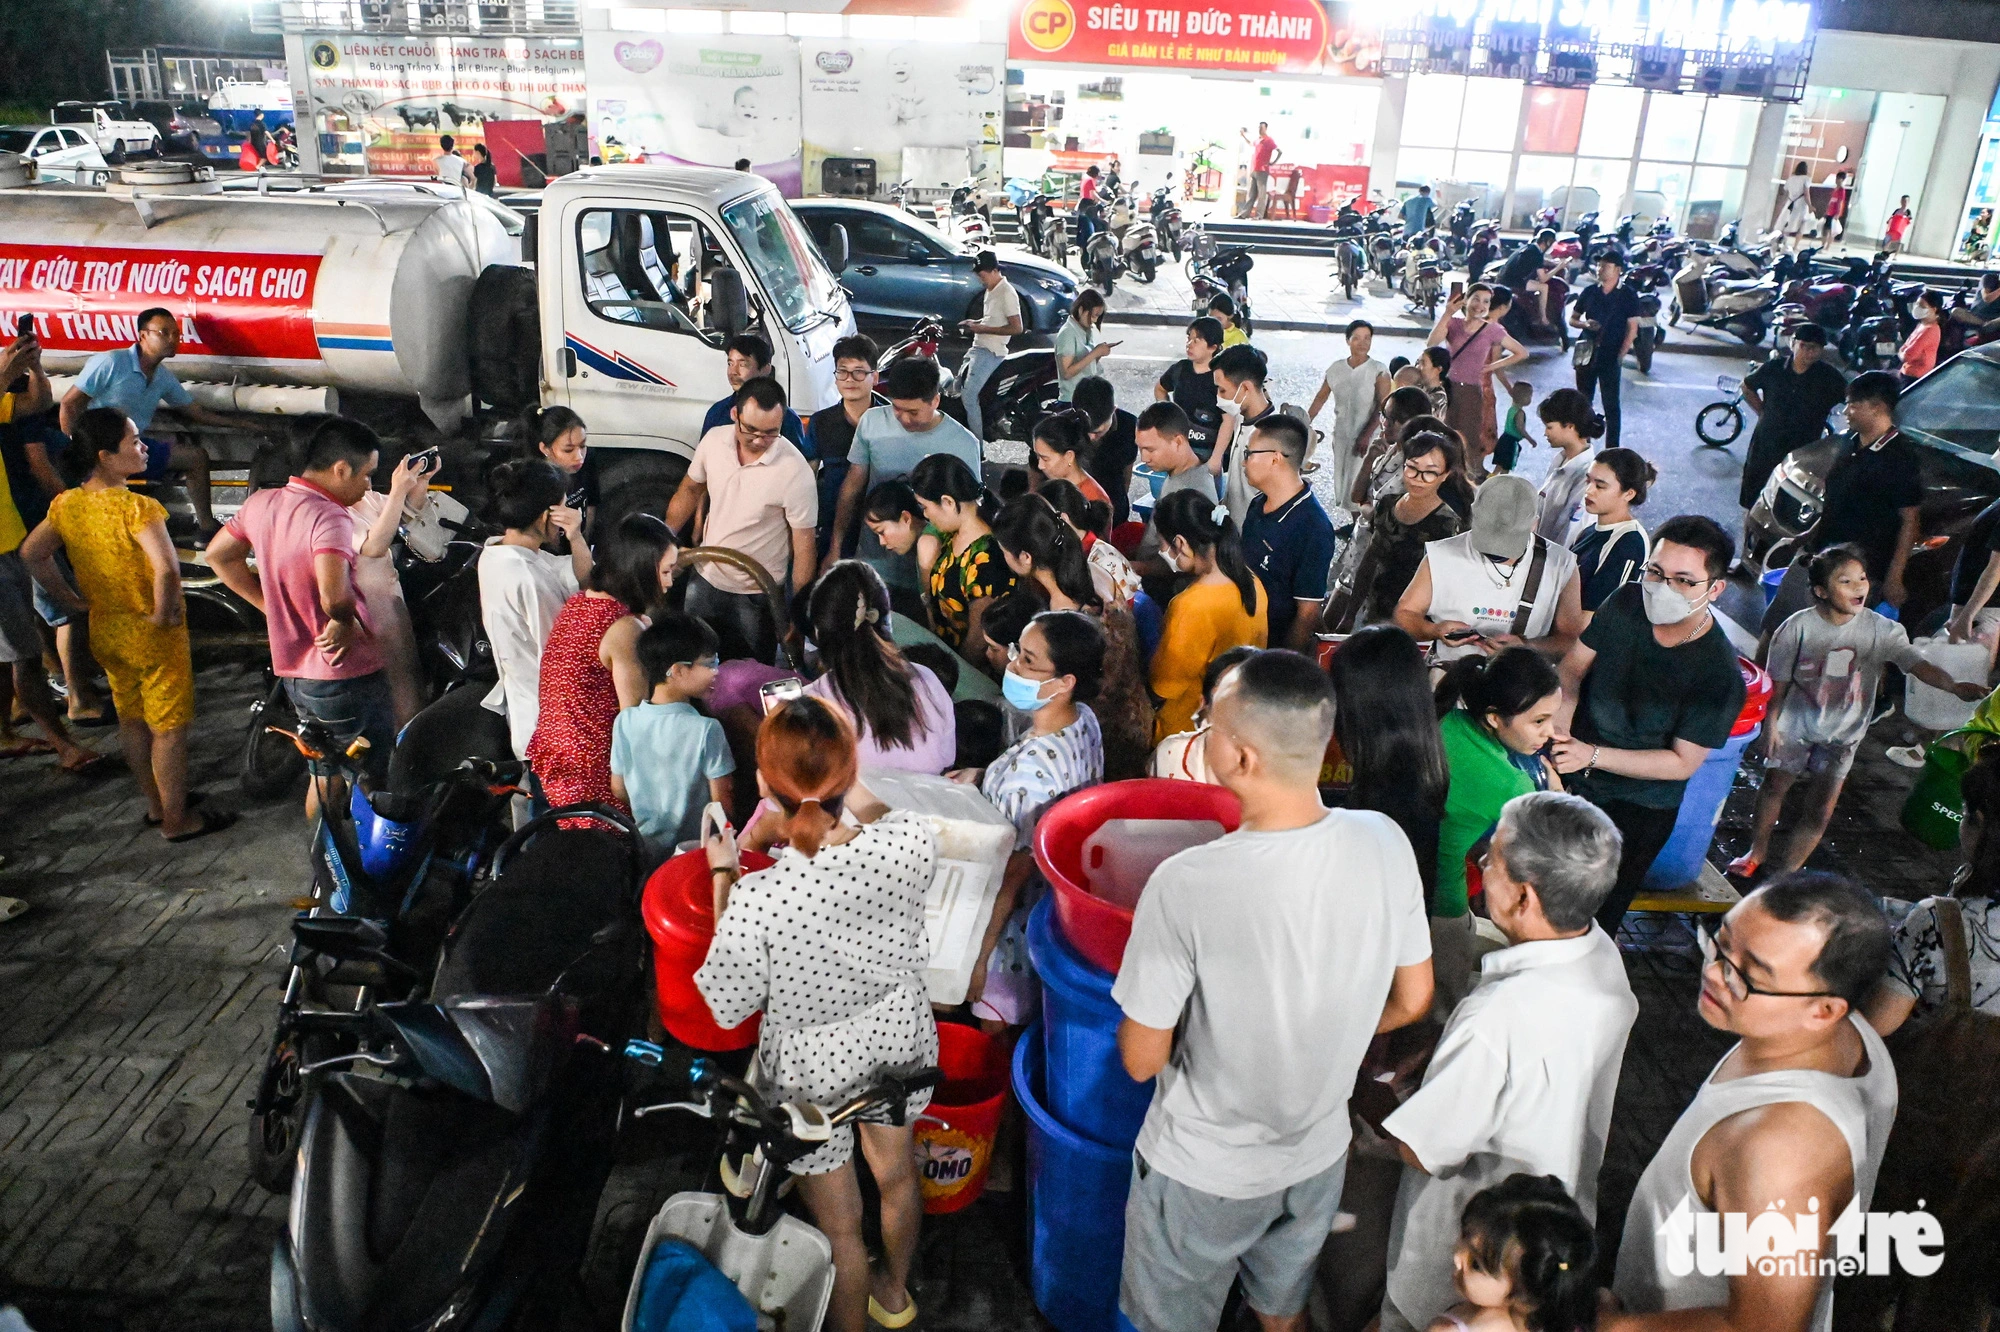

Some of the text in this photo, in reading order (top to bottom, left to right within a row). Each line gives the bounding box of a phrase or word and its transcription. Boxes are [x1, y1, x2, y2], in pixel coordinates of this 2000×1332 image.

[1029, 12, 1067, 34] CP
[1087, 7, 1313, 41] SIÊU THỊ ĐỨC THÀNH
[344, 43, 369, 56] LIÊN
[373, 42, 395, 56] KẾT
[398, 42, 436, 57] CHUỖI
[534, 49, 566, 62] SẠCH
[622, 47, 657, 61] Bobby
[1108, 42, 1286, 65] GIÁ BÁN LẺ RẺ NHƯ BÁN BUÔN
[384, 62, 405, 73] Lang
[475, 63, 499, 72] Blanc
[507, 64, 526, 73] Blue
[534, 65, 570, 75] Belgium
[421, 80, 443, 90] BBB
[31, 255, 79, 291] CỨU
[82, 259, 126, 300] TRỢ
[127, 259, 190, 294] NƯỚC
[194, 265, 257, 303] SẠCH
[260, 267, 308, 299] CHO
[923, 1157, 973, 1180] OMO
